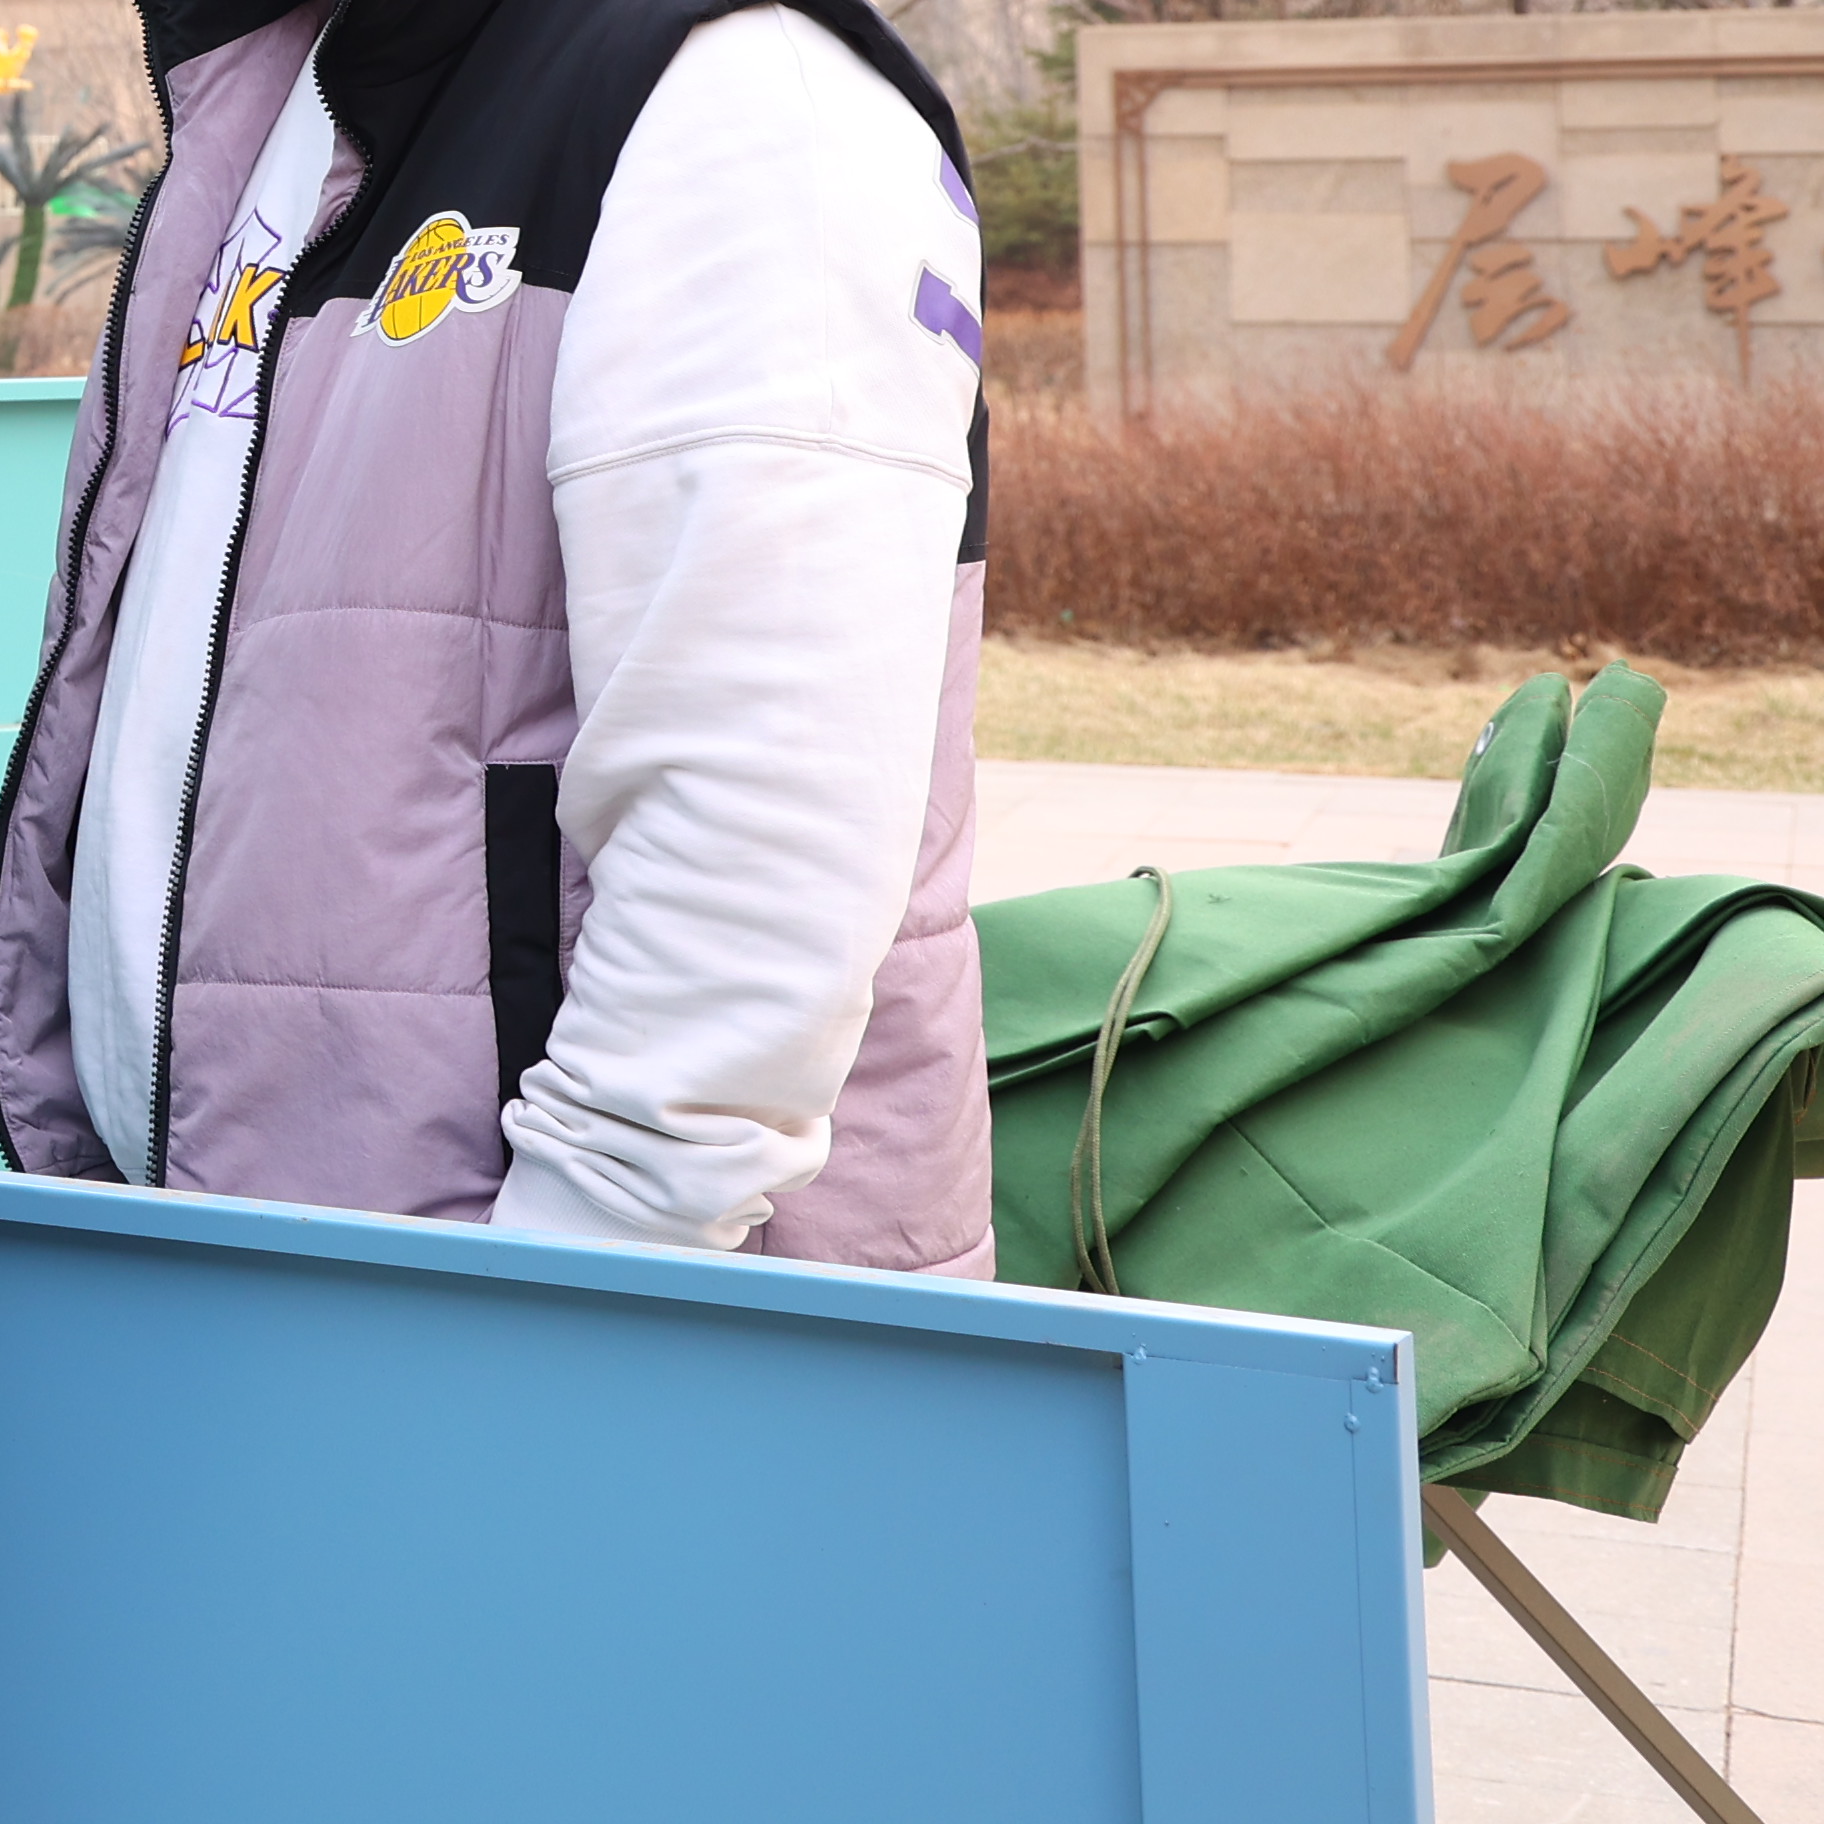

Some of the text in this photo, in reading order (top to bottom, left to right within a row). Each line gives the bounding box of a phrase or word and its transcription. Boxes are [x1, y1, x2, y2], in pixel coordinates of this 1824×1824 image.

[411, 234, 510, 264] LOS ANGELES
[362, 250, 510, 328] LAKERS
